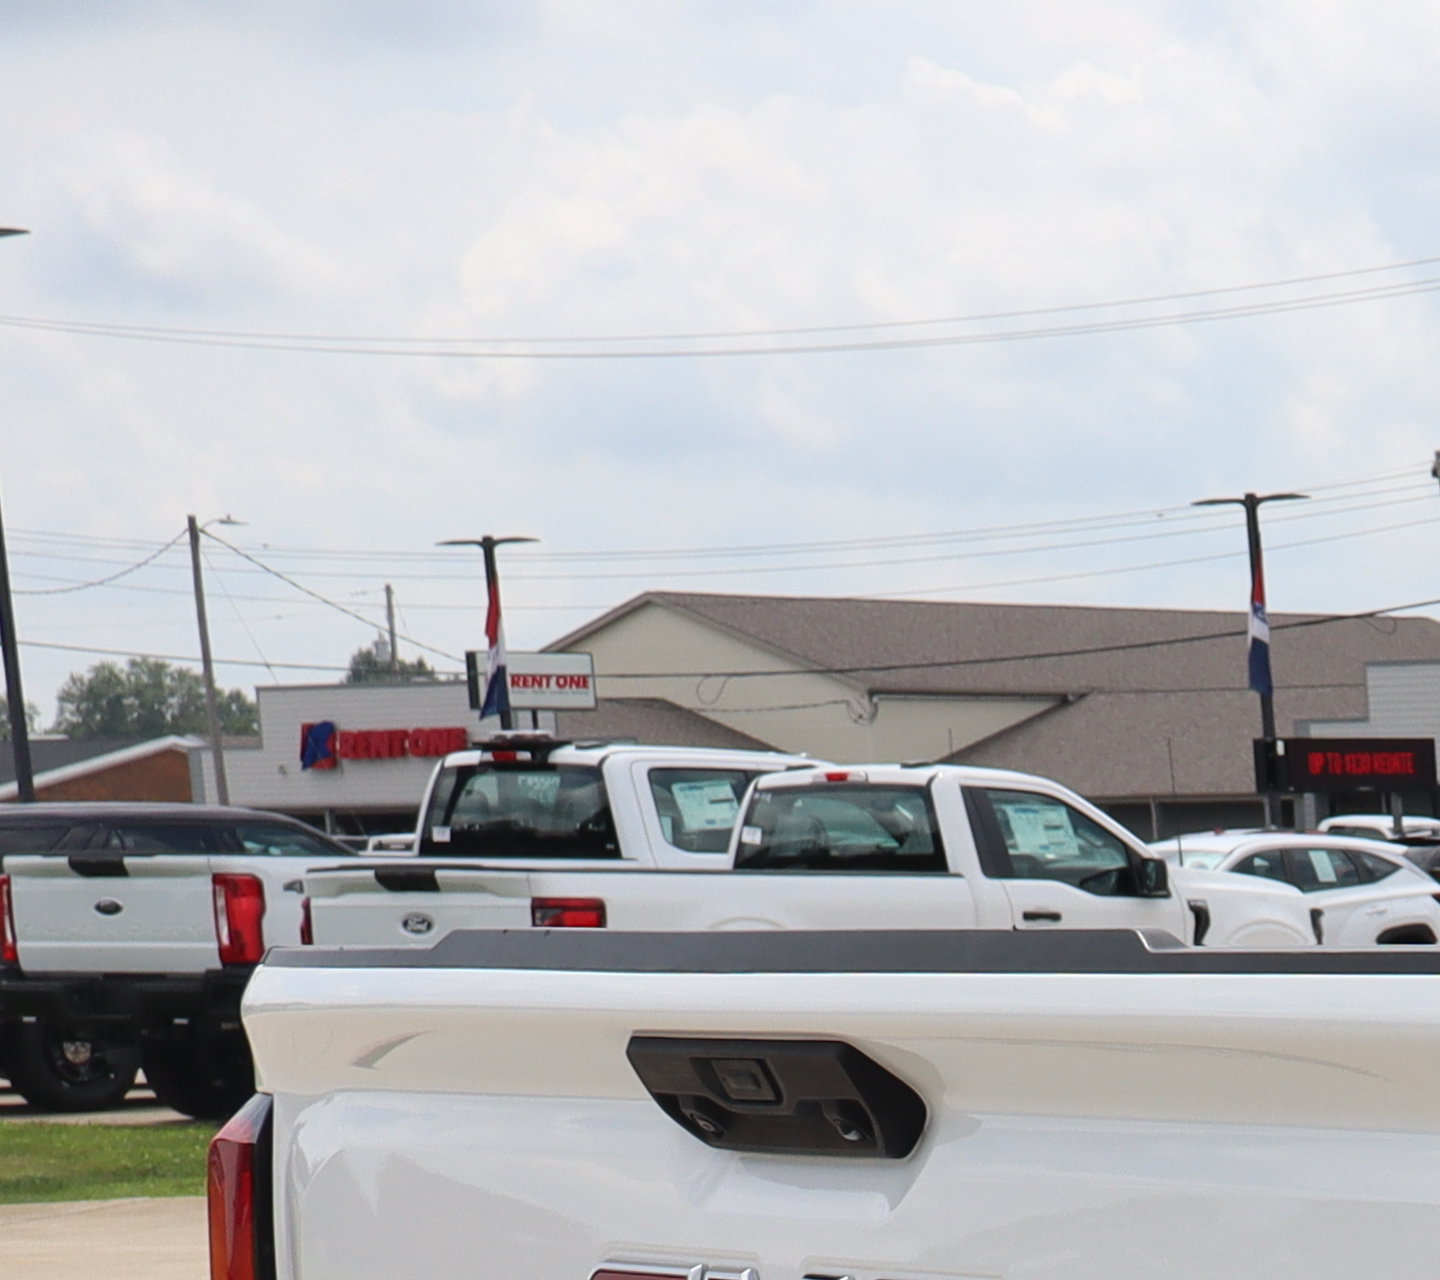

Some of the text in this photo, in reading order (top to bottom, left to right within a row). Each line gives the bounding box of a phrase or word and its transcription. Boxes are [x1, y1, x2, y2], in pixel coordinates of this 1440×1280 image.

[510, 674, 589, 690] RENT ONE
[339, 727, 468, 760] RENT ONE
